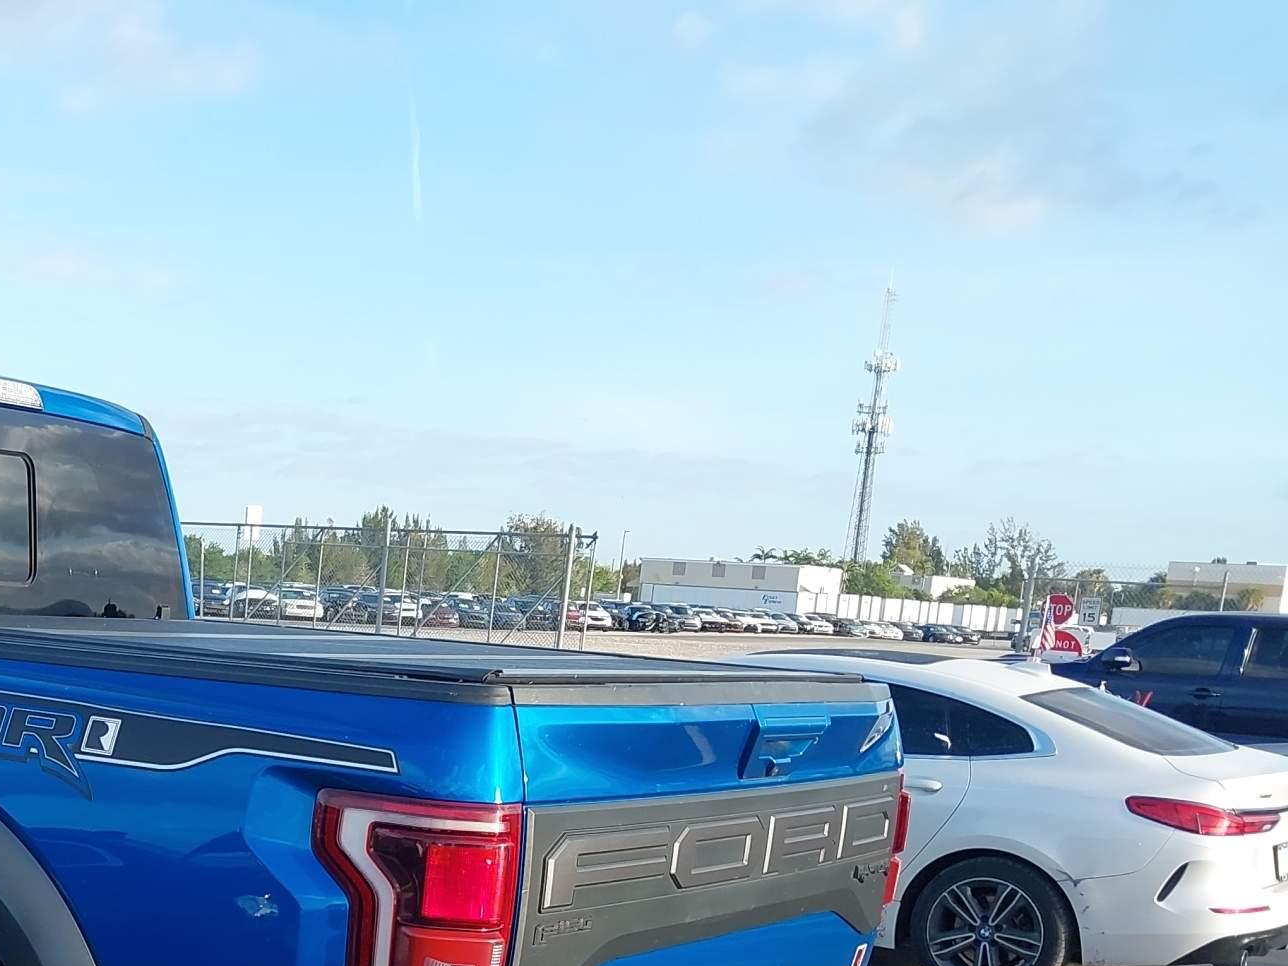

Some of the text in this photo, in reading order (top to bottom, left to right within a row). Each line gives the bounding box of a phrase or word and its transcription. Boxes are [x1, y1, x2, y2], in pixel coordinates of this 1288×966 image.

[1049, 603, 1073, 616] TOP
[1082, 612, 1096, 623] 15
[1055, 639, 1077, 649] NOT
[539, 796, 895, 912] FORD
